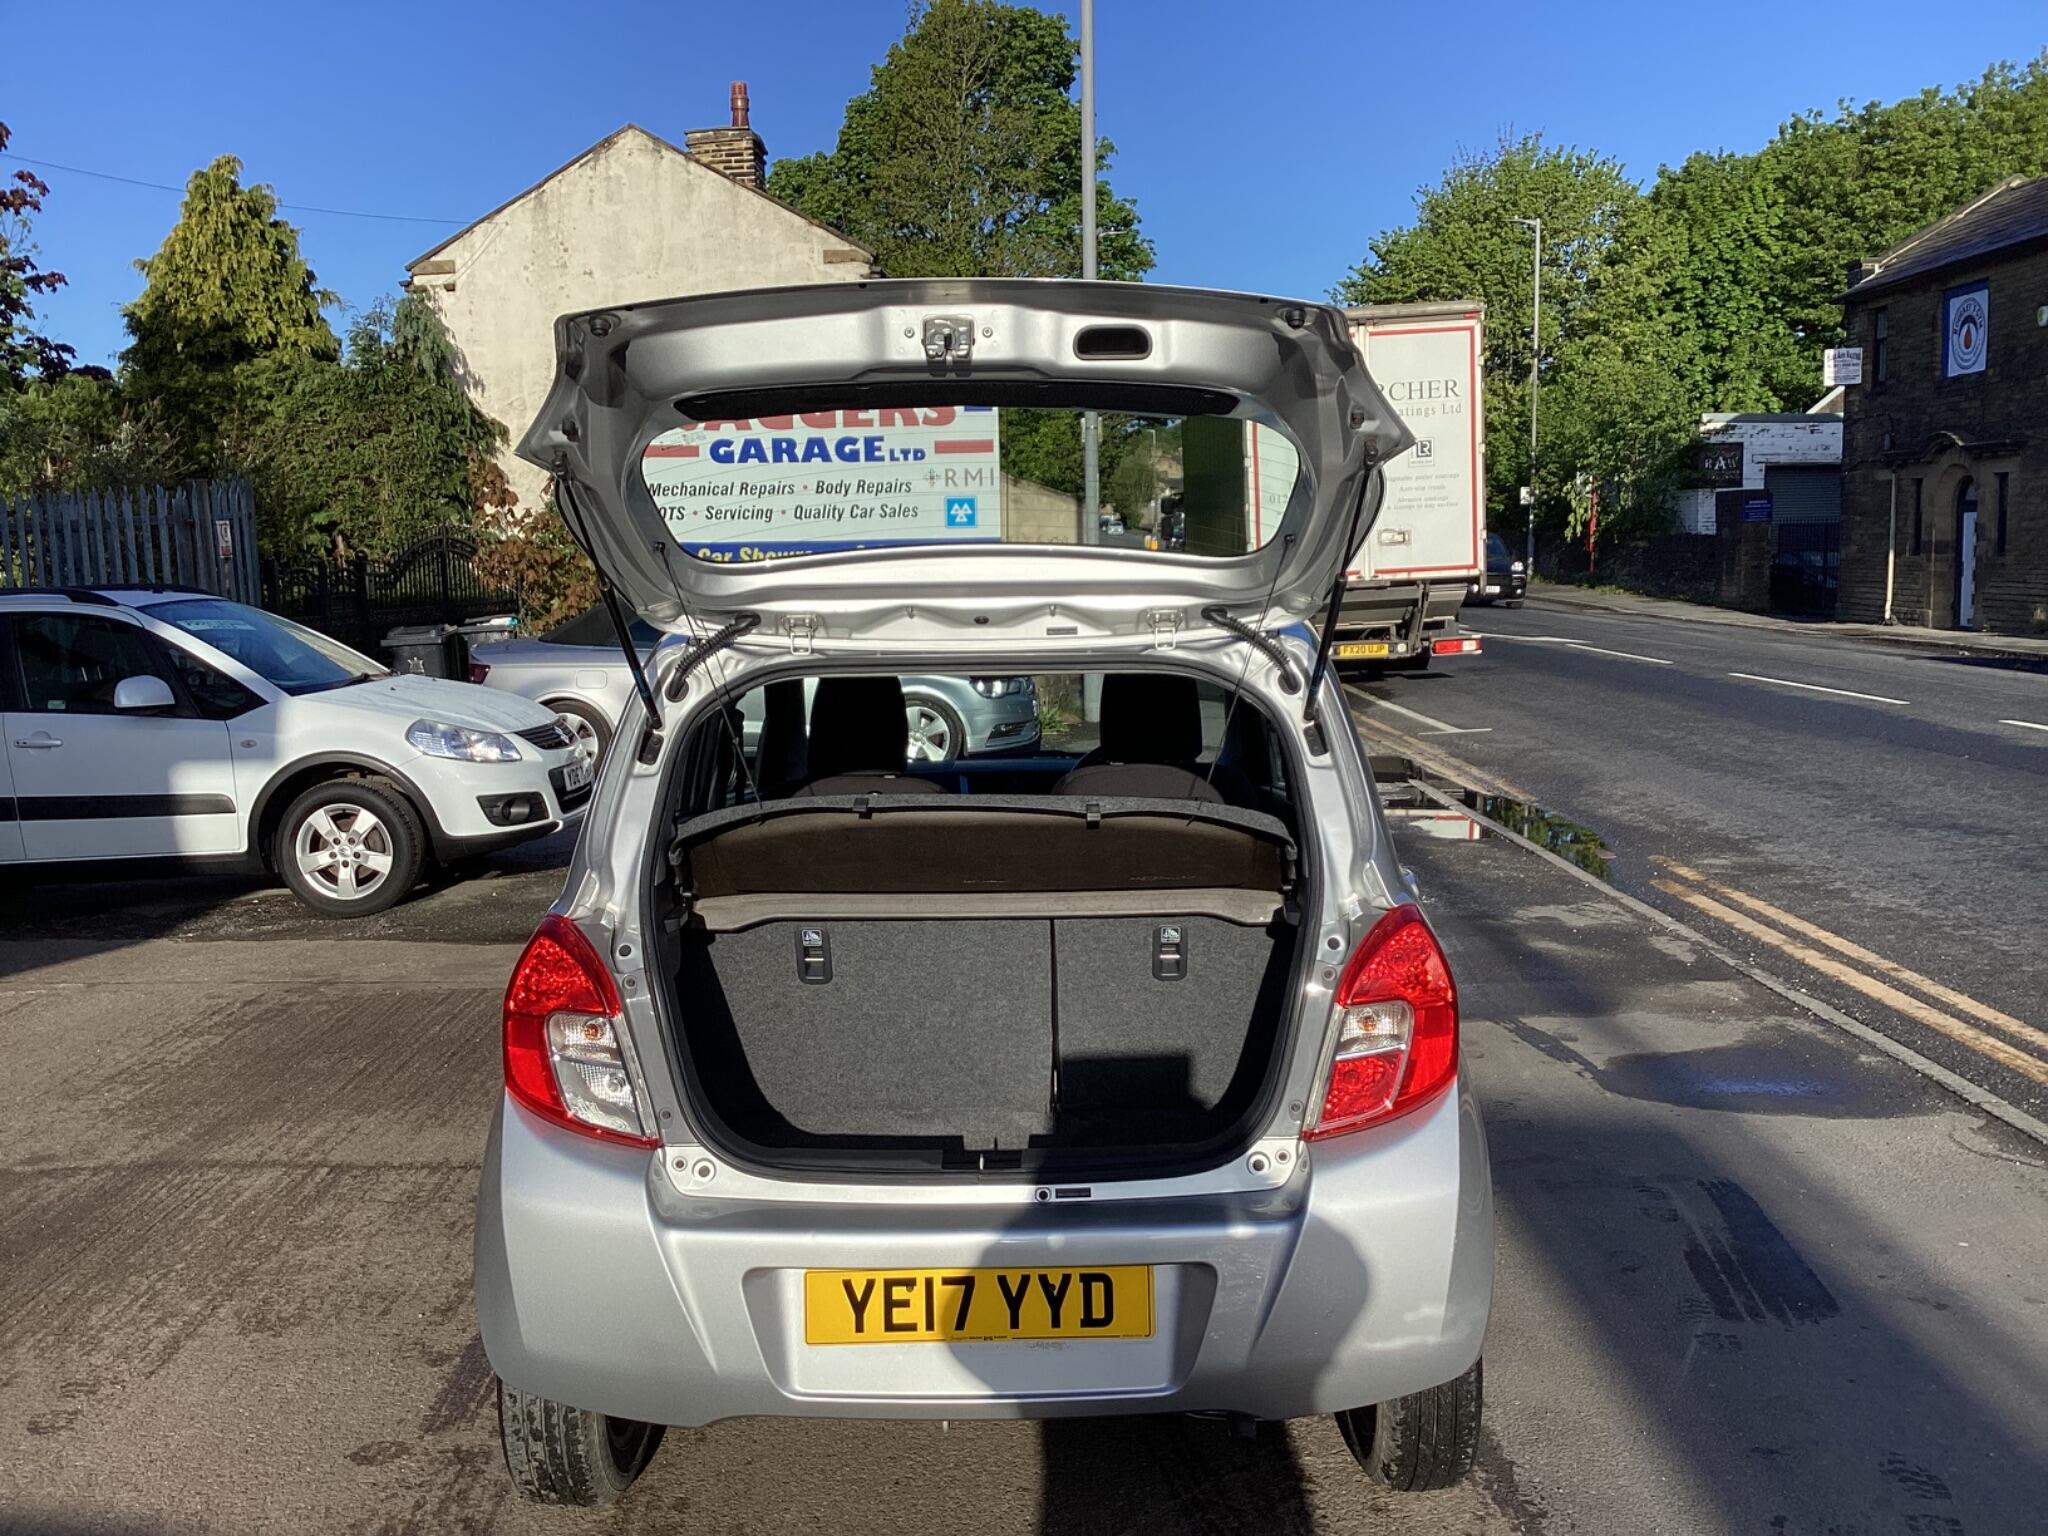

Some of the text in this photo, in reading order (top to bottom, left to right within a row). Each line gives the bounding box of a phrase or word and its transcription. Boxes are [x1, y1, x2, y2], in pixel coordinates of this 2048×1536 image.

[1442, 403, 1462, 415] Ltd
[709, 436, 926, 464] GARAGE LTD
[944, 467, 994, 488] RMI
[649, 478, 912, 498] Mechanical Repairs Body Repairs
[705, 505, 774, 523] Servicing
[794, 504, 845, 522] Quality
[850, 504, 875, 519] Car
[880, 503, 919, 518] Sales
[842, 1273, 1114, 1333] YE17 YYD
